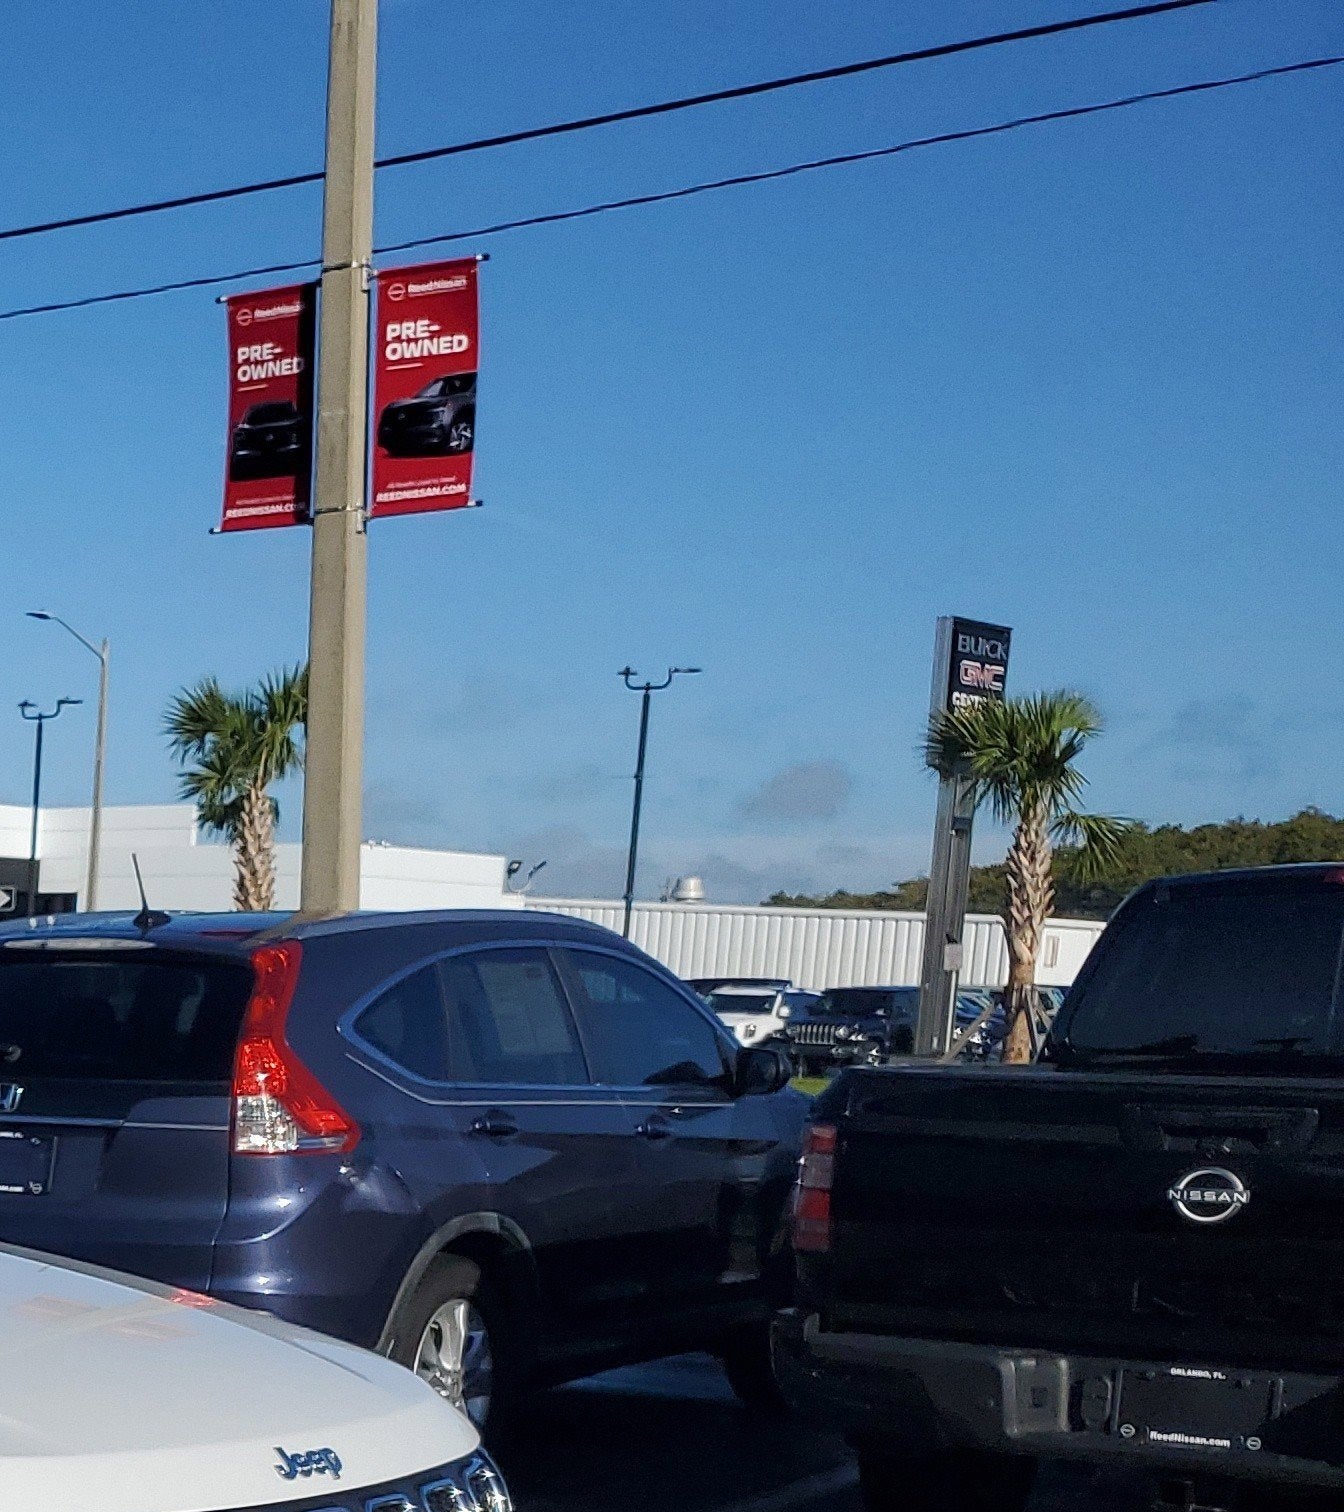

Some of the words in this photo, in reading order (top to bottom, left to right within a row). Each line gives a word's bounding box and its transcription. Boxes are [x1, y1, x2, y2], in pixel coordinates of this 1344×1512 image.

[386, 319, 441, 341] PRE-
[237, 342, 284, 365] PRE-
[385, 334, 469, 361] OWNED
[237, 357, 305, 382] OWNED
[958, 633, 1007, 660] BUICK
[959, 659, 1005, 692] GMC
[1168, 1189, 1249, 1204] NISSAN
[1150, 1430, 1231, 1448] ReedNissan.com
[273, 1446, 343, 1480] Jeep
